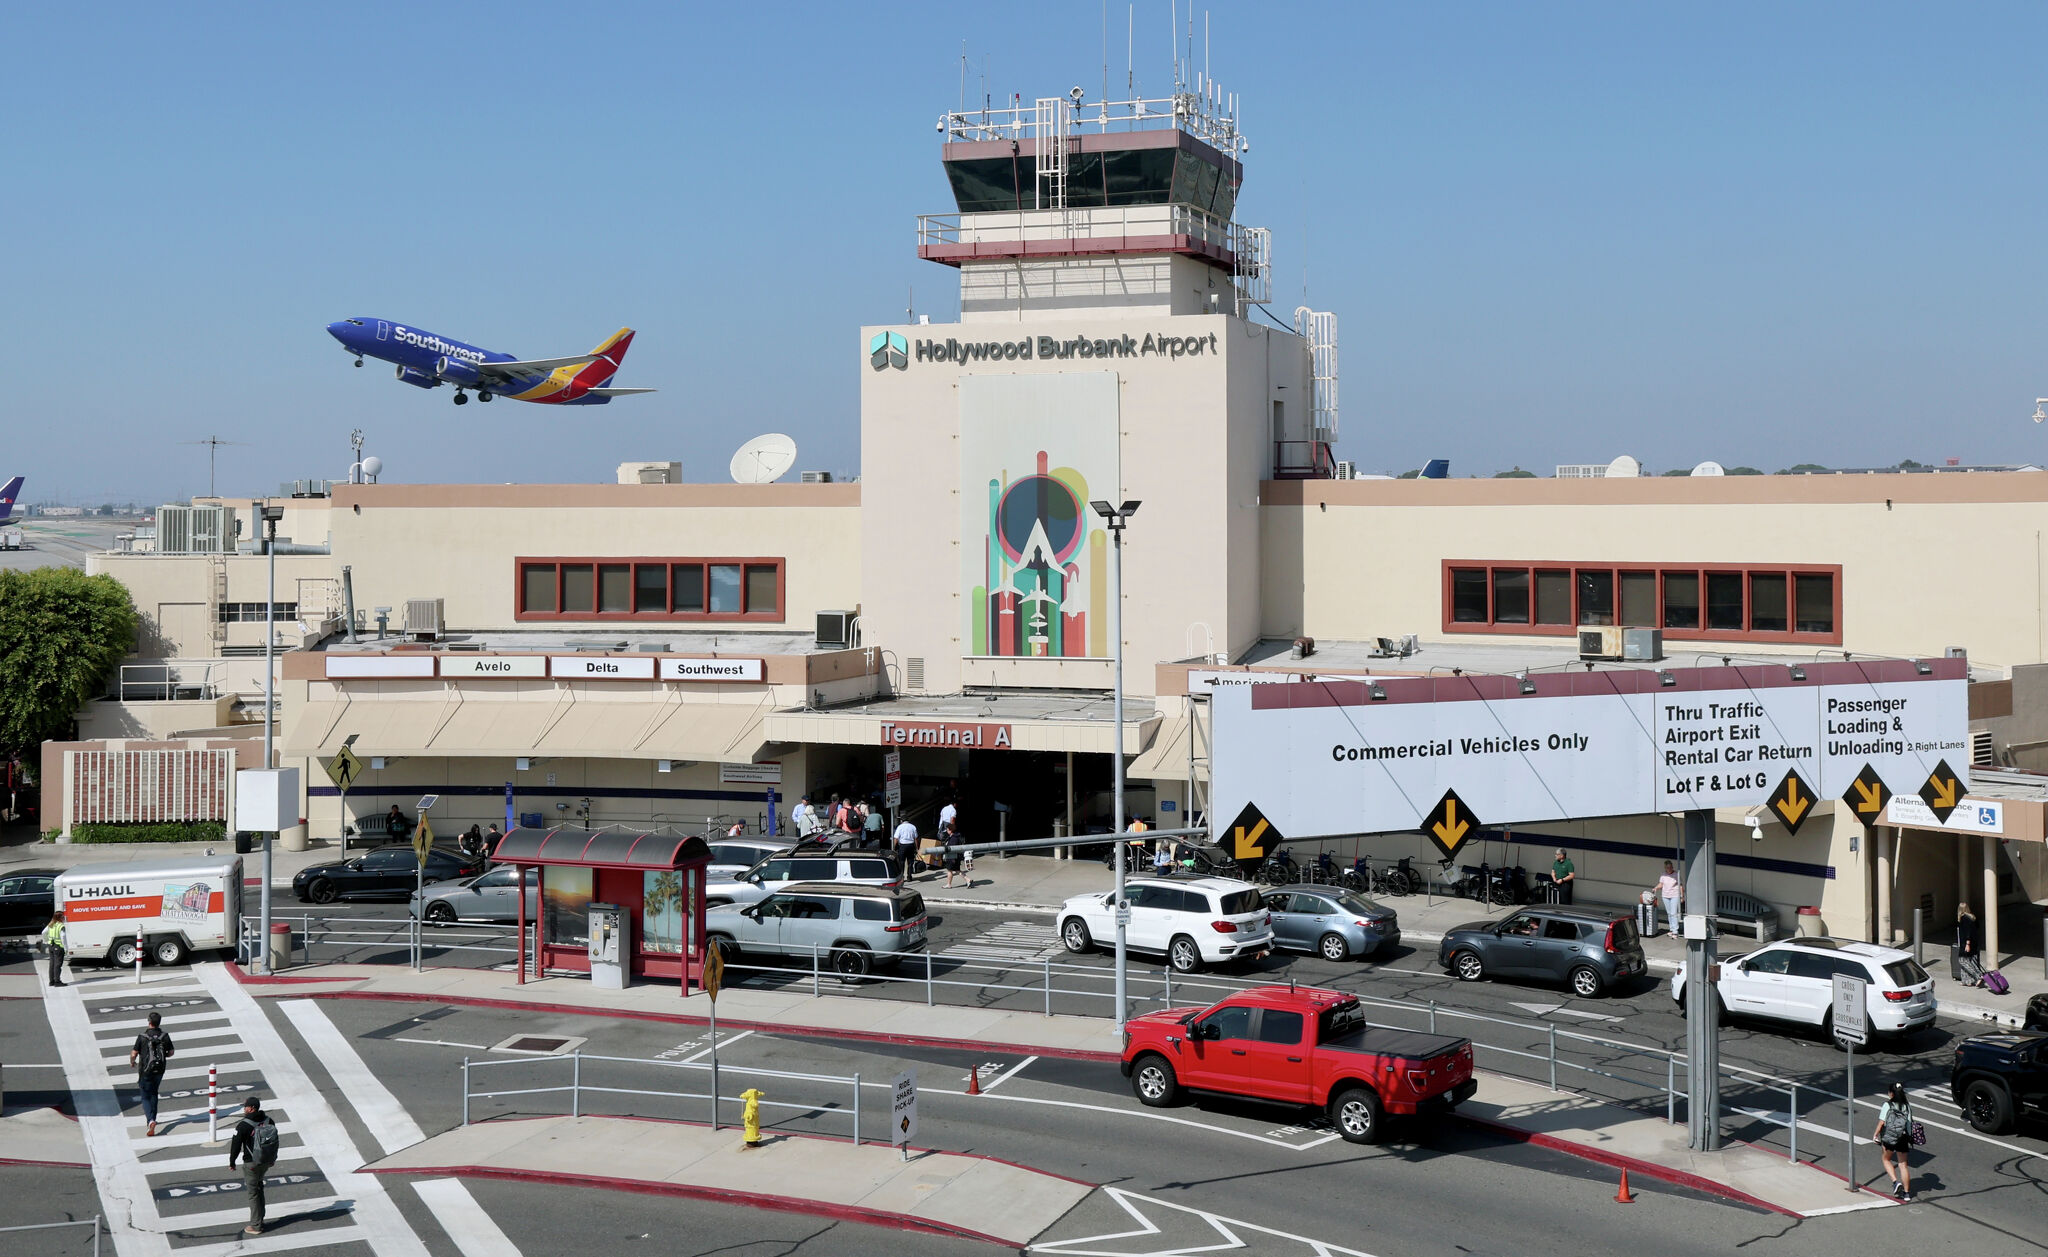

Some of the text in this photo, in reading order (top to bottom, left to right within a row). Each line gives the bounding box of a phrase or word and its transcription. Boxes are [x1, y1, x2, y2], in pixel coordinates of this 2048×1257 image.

[394, 326, 486, 363] Southwest
[915, 332, 1217, 367] Hollywood Burbank Airport
[475, 661, 511, 672] Avelo
[586, 662, 619, 673] Delta
[678, 664, 744, 675] Southwest
[1665, 702, 1764, 721] Thru Traffic
[1827, 698, 1907, 717] Passenger
[881, 722, 1011, 747] Terminal A
[1665, 724, 1761, 746] Airport Exit
[1828, 716, 1903, 738] Loading &
[1332, 733, 1589, 762] Commercial Vehicles Only
[1665, 744, 1812, 766] Rental Car Return
[1828, 738, 1965, 757] Unloading 2 Right Lanes
[1666, 772, 1767, 794] Lot F & Lot G
[69, 885, 135, 898] U-HAUL
[120, 1001, 187, 1011] LOOK
[898, 1078, 911, 1091] RIDE
[896, 1087, 913, 1102] SHARE
[894, 1096, 915, 1113] PICK-UP
[194, 1176, 288, 1194] LOK
